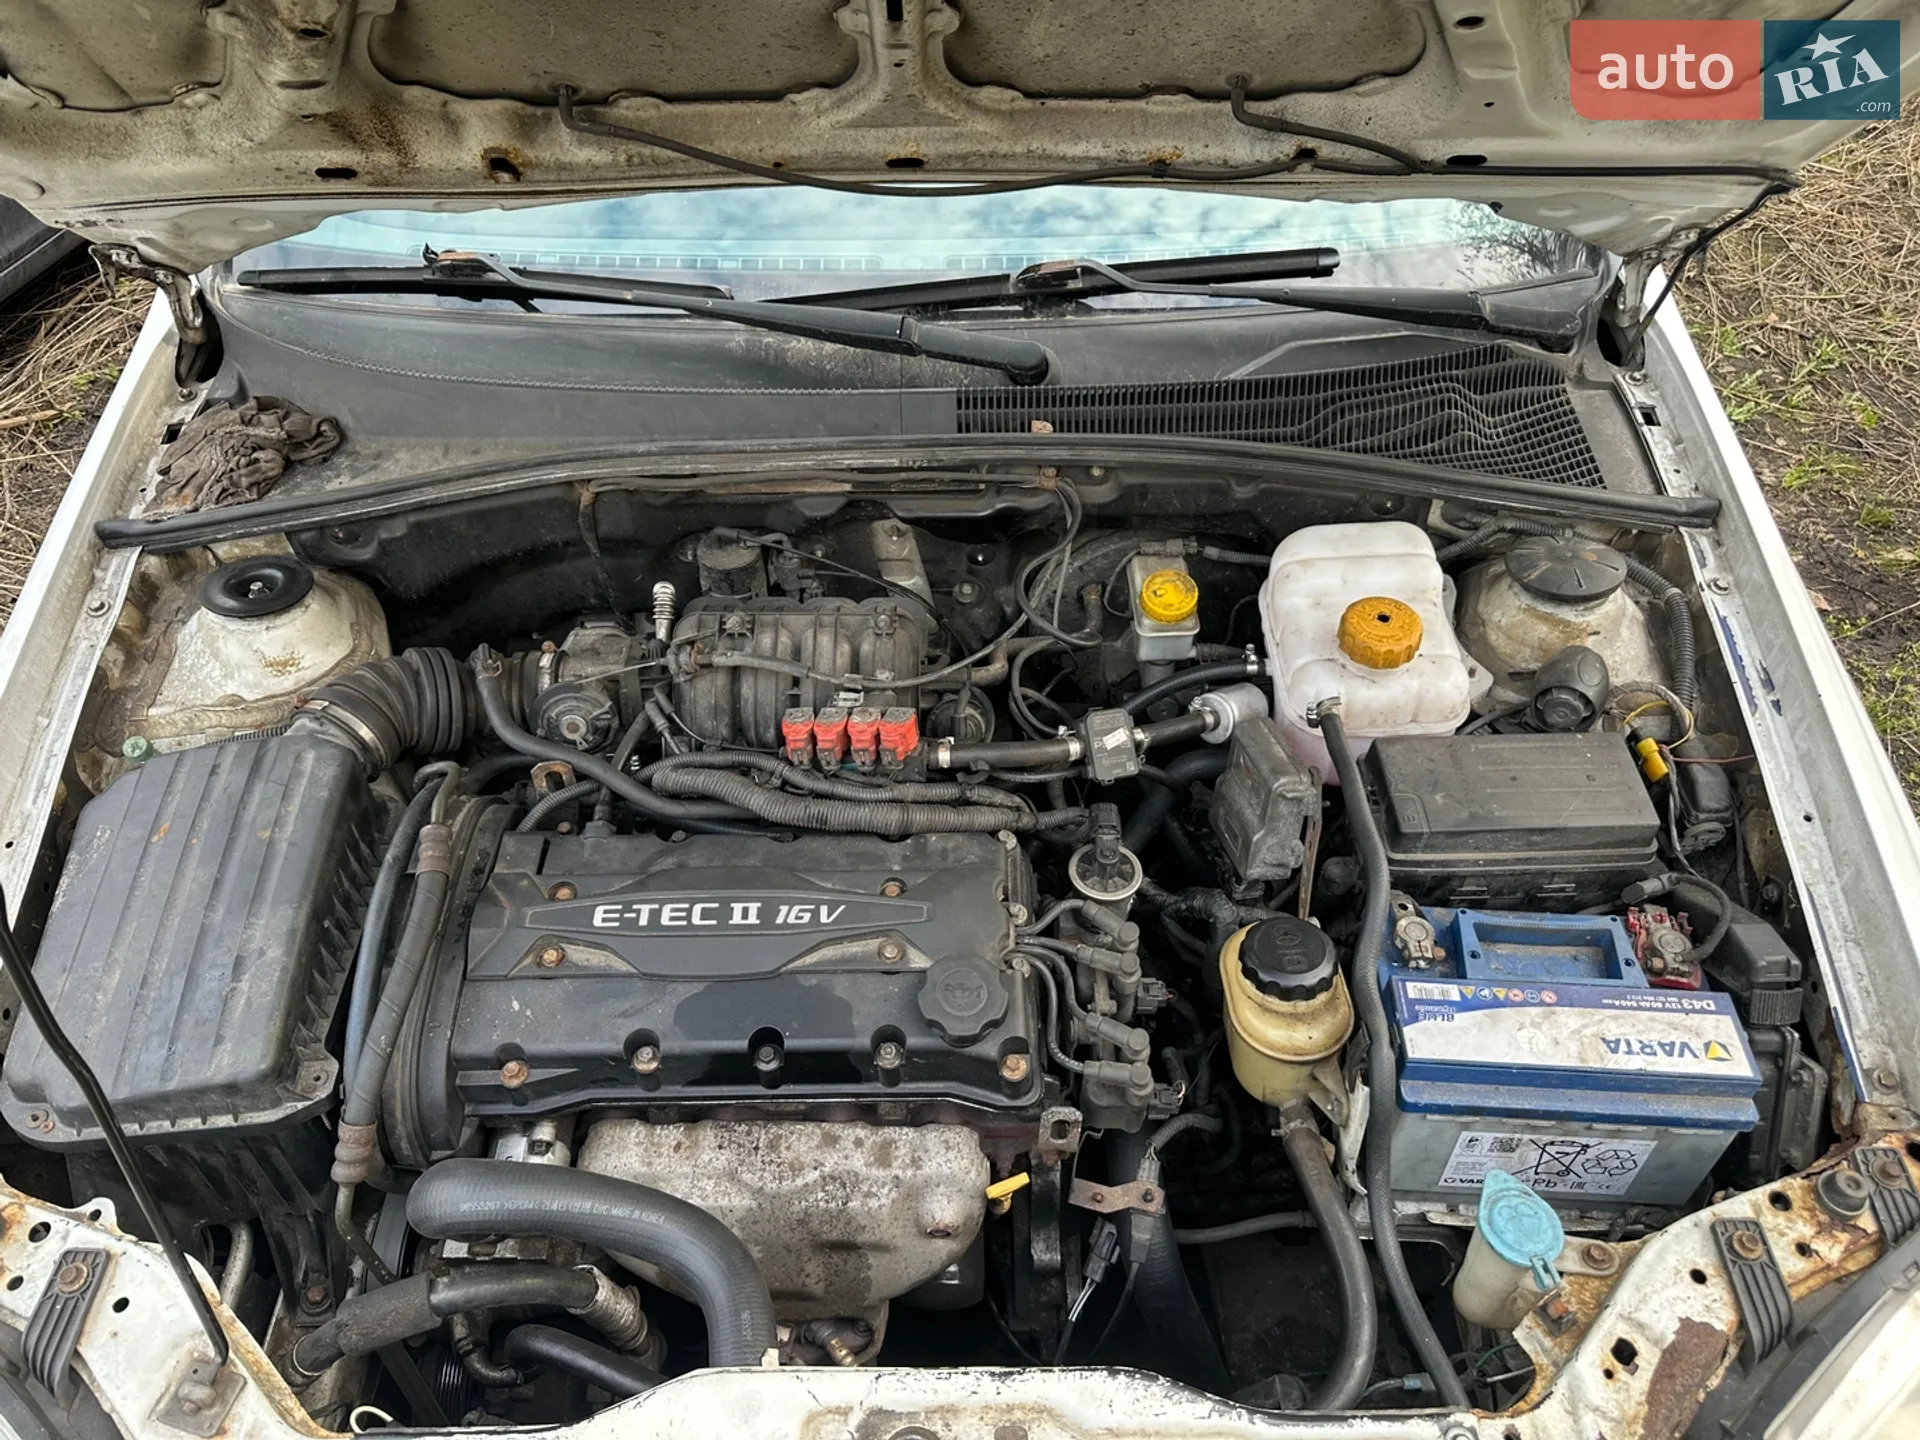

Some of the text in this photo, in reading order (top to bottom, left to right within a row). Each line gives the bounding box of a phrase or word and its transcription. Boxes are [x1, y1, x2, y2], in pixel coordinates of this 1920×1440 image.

[592, 903, 720, 927] E-TEC
[775, 905, 846, 925] 16V
[1682, 999, 1716, 1011] D43
[1418, 1012, 1455, 1022] BLUE
[1600, 1037, 1700, 1059] VARTA
[1532, 1178, 1557, 1188] Pb
[611, 1206, 633, 1219] MADE
[642, 1210, 665, 1225] KOREA
